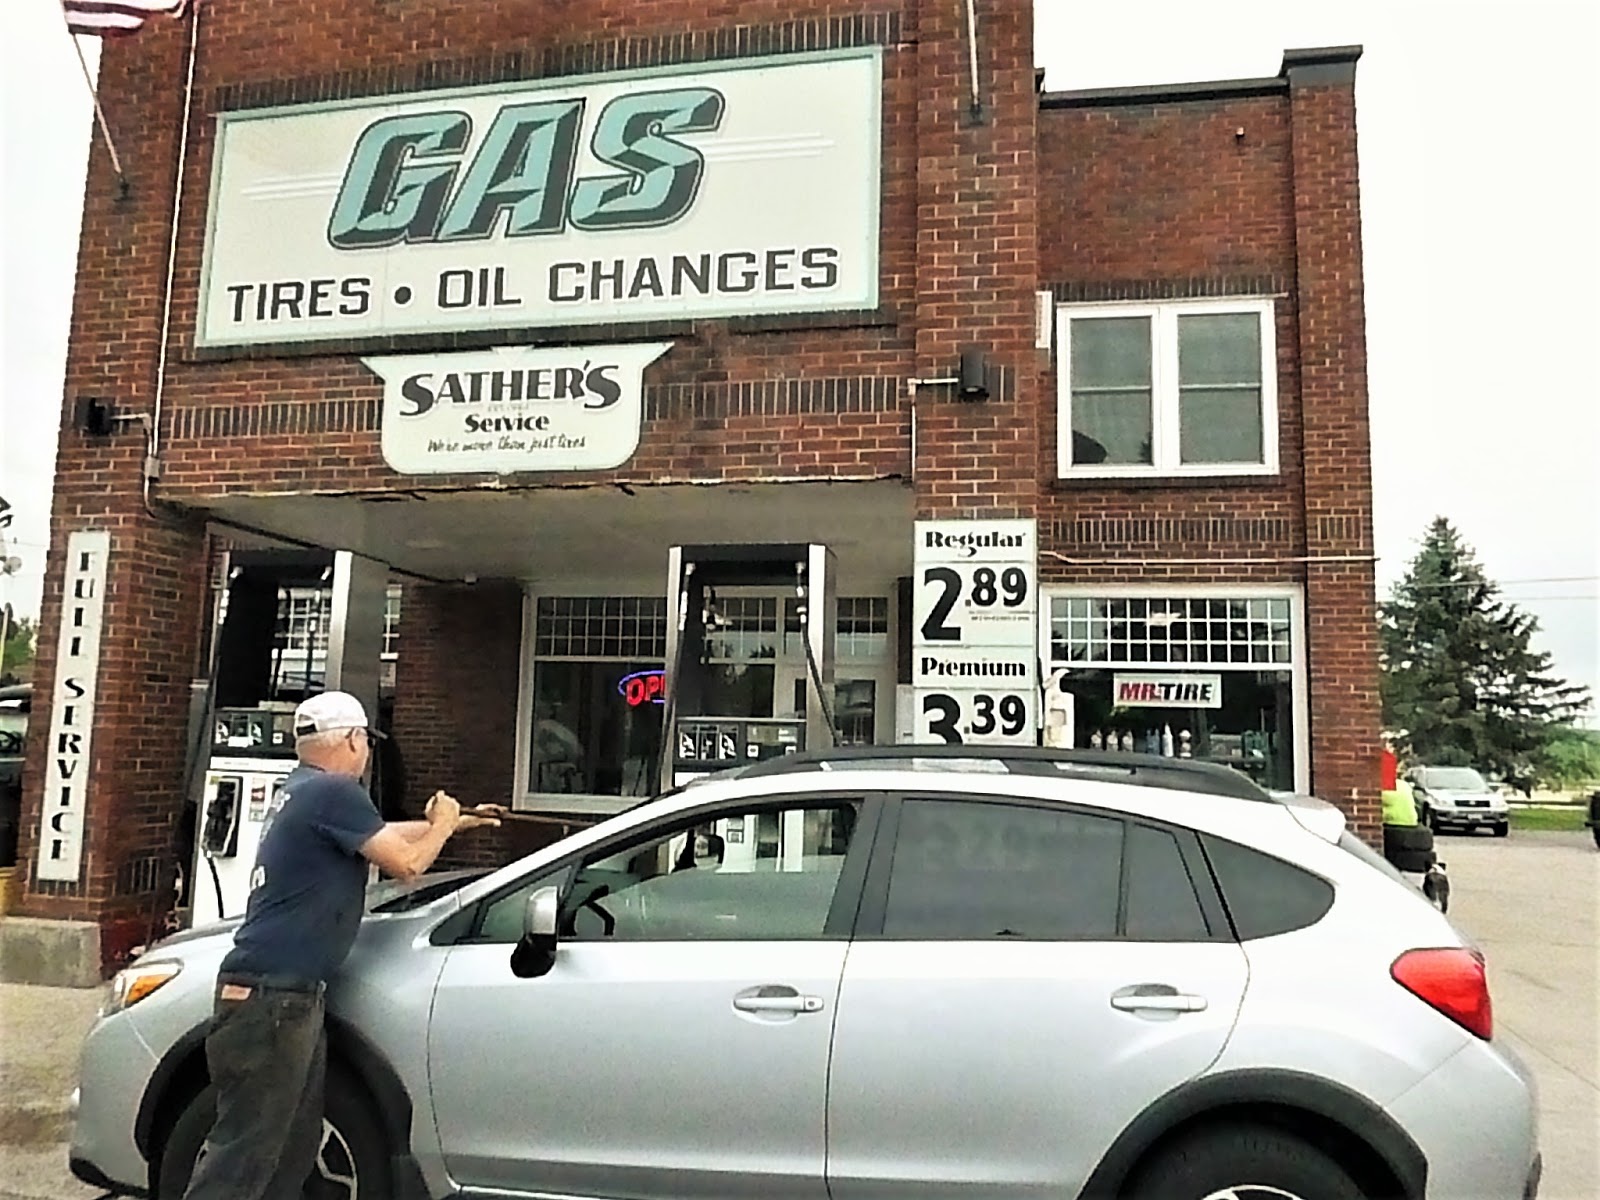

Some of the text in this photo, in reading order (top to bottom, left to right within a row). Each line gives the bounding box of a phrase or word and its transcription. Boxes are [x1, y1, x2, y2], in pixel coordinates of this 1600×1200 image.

[328, 87, 726, 250] GAS
[227, 247, 839, 322] TIRES OIL CHANGES
[399, 359, 622, 417] SATHER'S
[464, 413, 550, 434] Service
[497, 434, 525, 451] than
[526, 435, 557, 454] just
[557, 433, 586, 449] tires
[925, 531, 1027, 558] Regular
[920, 566, 1028, 641] 2.89
[920, 657, 1026, 677] Premium
[626, 675, 666, 706] OP
[1157, 683, 1213, 702] TIRE
[51, 551, 97, 862] FULL SERVICE
